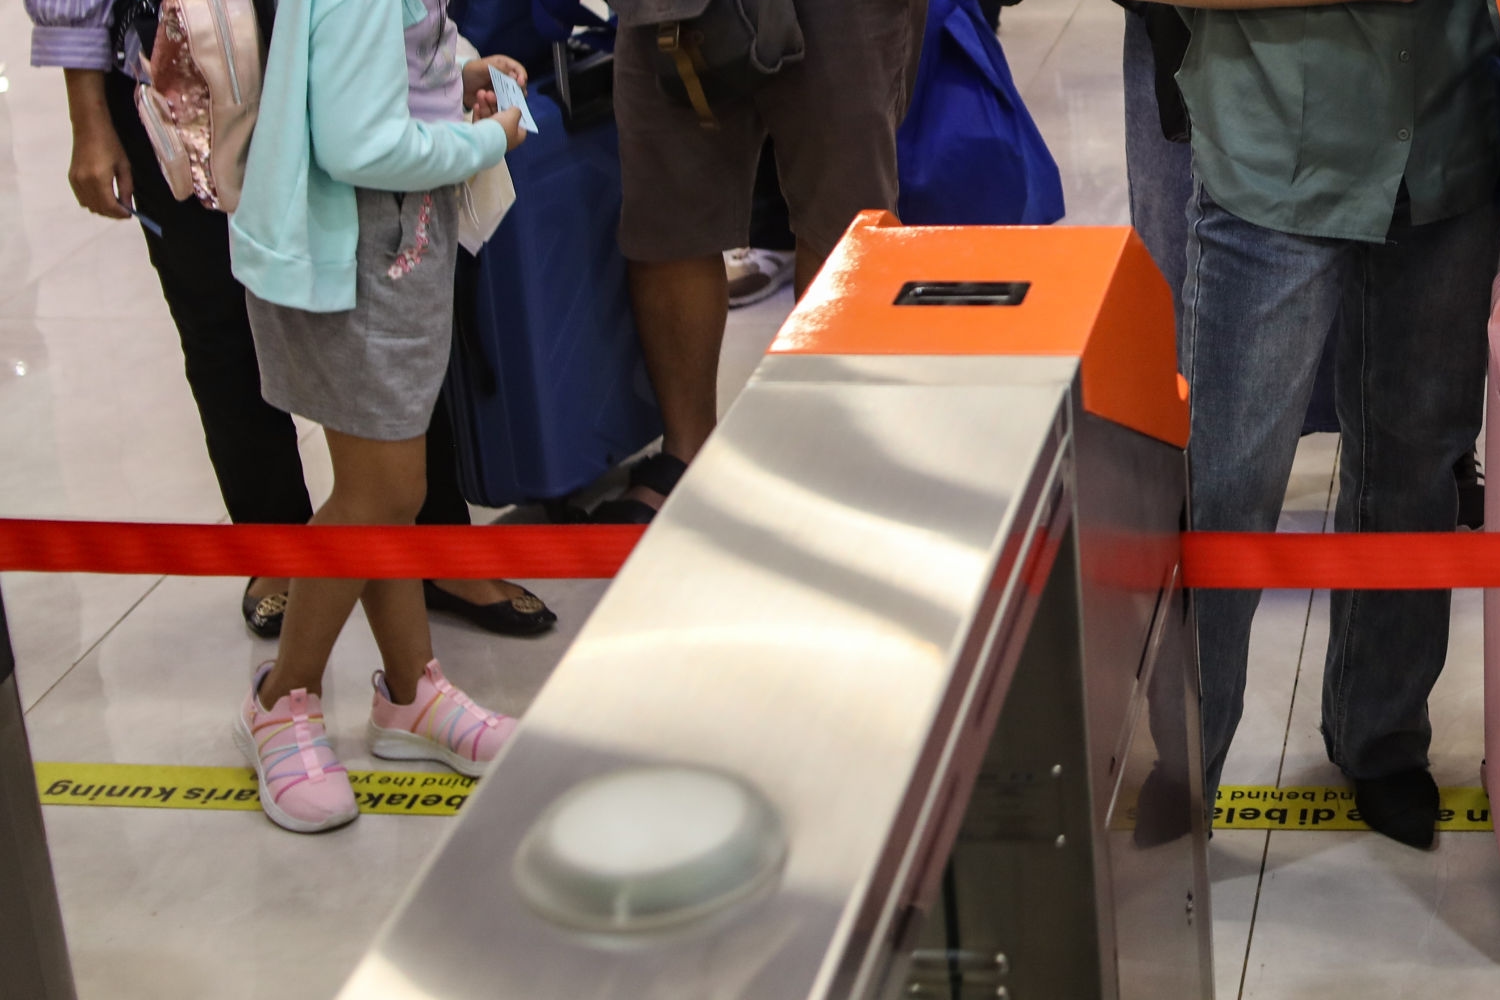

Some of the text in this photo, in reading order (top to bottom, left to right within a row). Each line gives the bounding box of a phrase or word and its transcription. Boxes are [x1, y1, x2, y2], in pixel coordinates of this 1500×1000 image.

[379, 774, 416, 788] the
[422, 776, 479, 789] hind
[43, 779, 261, 804] aris kuning
[1230, 789, 1316, 803] behind
[1299, 807, 1336, 826] di
